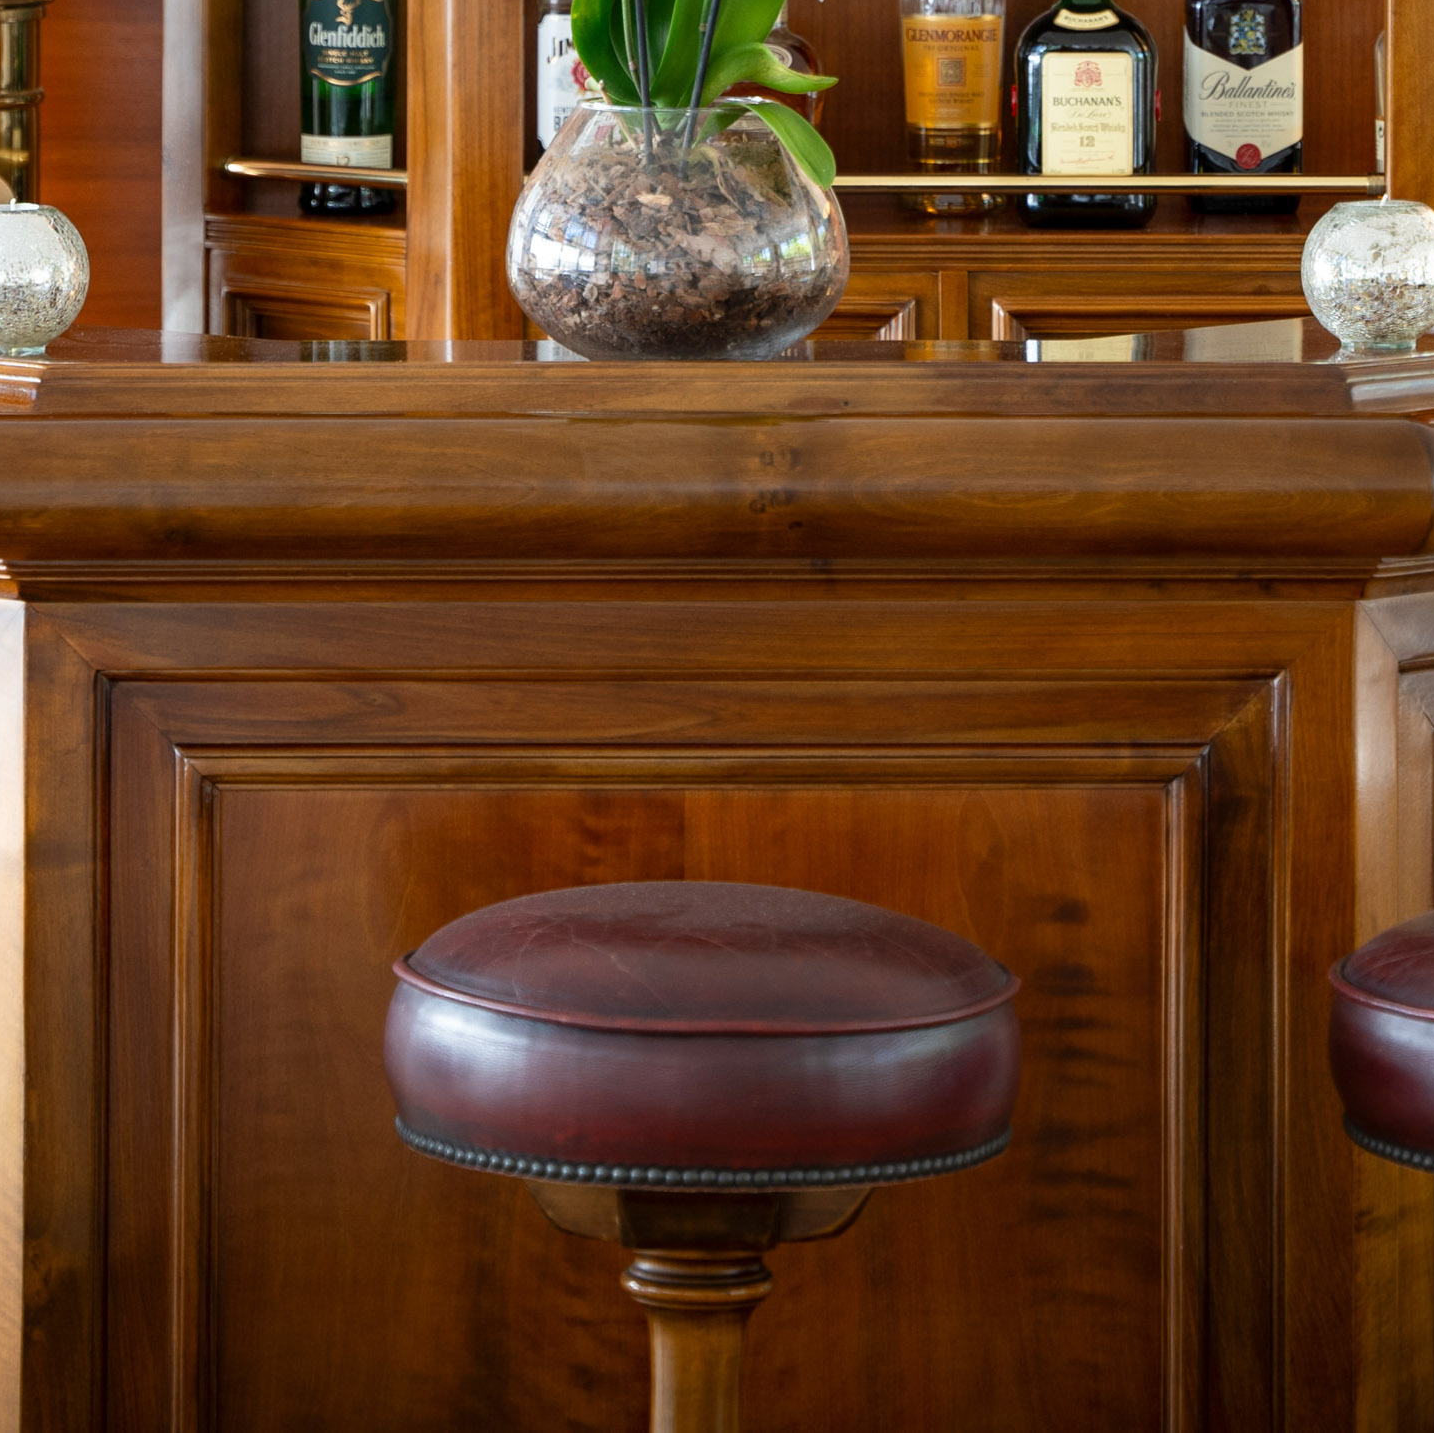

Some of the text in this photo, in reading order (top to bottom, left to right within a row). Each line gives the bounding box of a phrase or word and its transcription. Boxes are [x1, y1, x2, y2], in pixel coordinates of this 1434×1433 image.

[309, 21, 386, 48] Glenfiddich
[905, 28, 998, 43] GLENMORANGIE
[1199, 71, 1296, 101] Ballantine's
[1053, 96, 1122, 107] BUCHANAN'S
[1228, 101, 1268, 109] FINEST
[1079, 135, 1096, 148] 12
